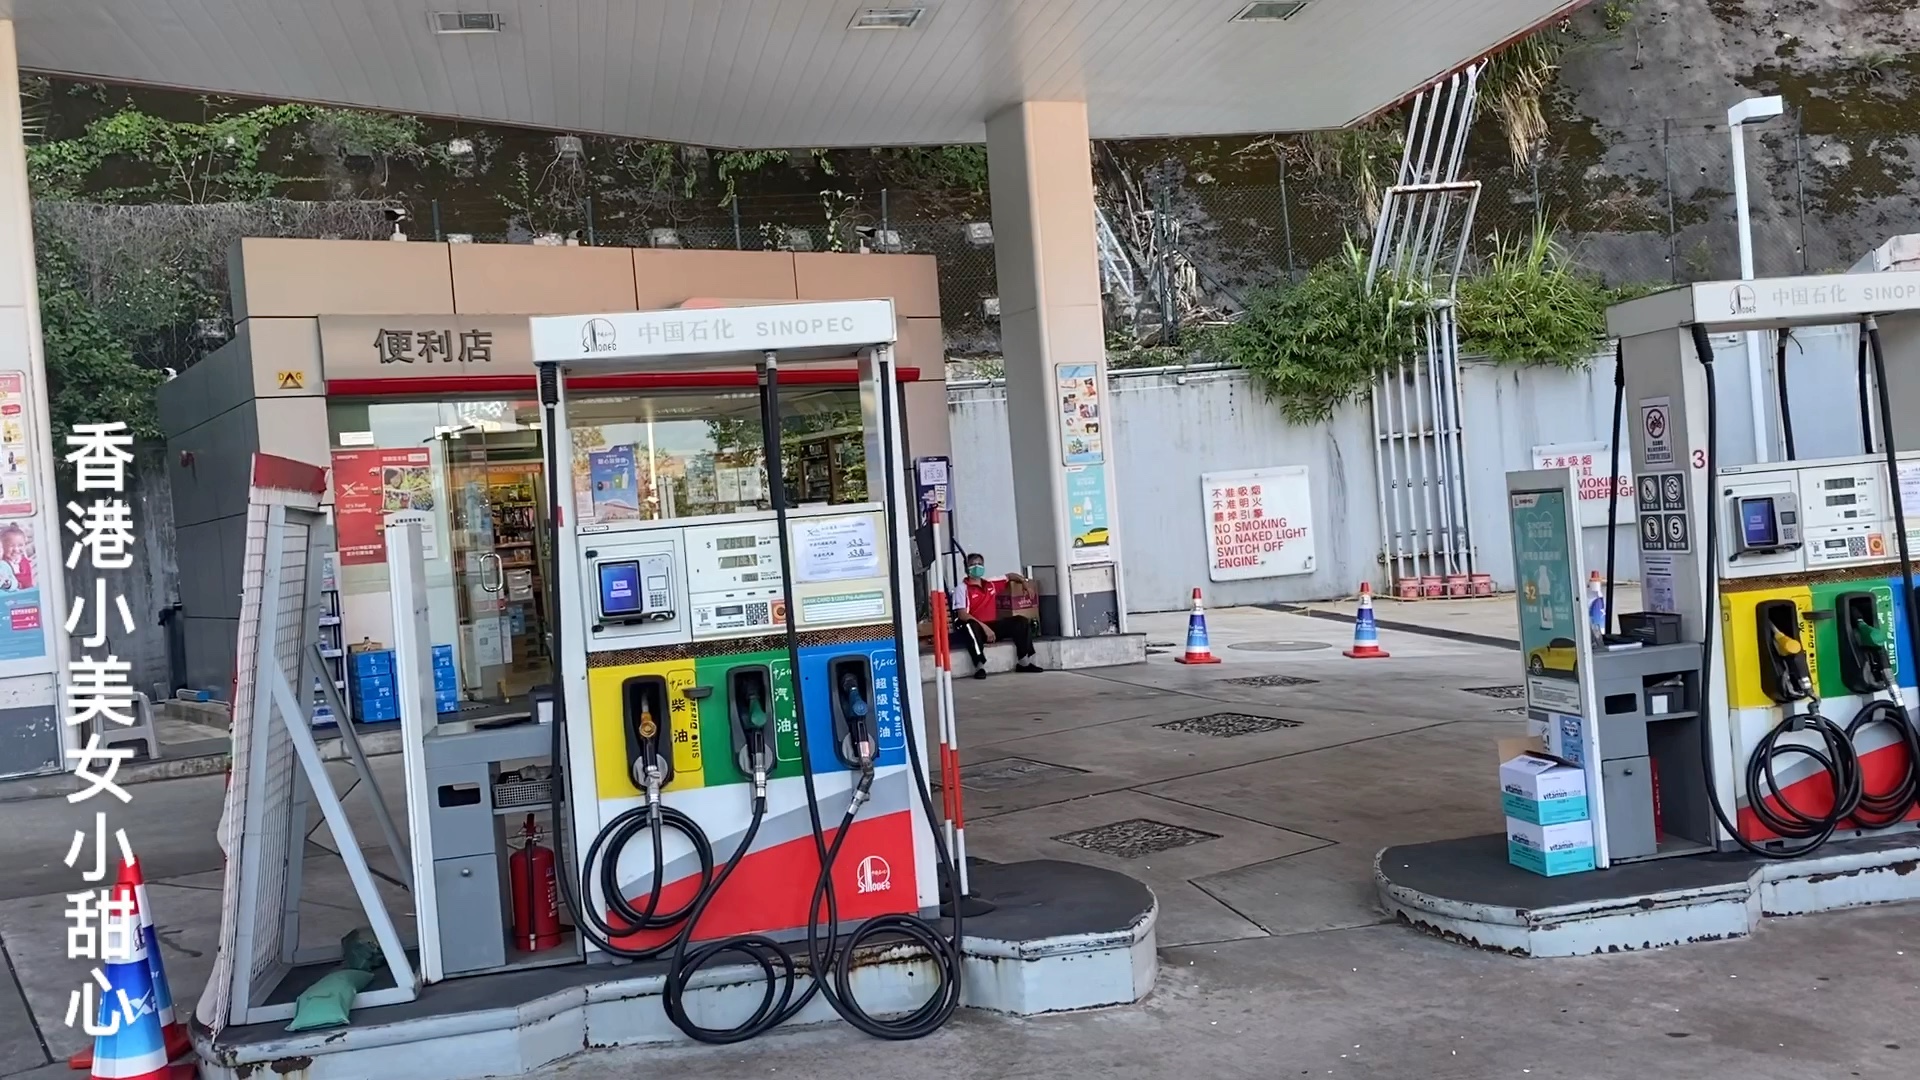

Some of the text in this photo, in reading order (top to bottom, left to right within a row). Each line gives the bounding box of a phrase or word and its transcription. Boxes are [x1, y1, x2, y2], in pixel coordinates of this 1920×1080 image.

[1773, 285, 1846, 306] 中国石化
[1863, 284, 1920, 301] SINOP
[638, 318, 734, 344] 中国石化
[756, 317, 854, 337] SINOPEC
[373, 328, 493, 364] 便利店
[1542, 455, 1592, 468] 不准吸烟
[1692, 449, 1706, 469] 3
[1577, 475, 1627, 488] MOKIG
[1213, 497, 1262, 510] 不准明火
[1214, 517, 1287, 534] NO SMOKING
[1672, 522, 1680, 535] 5
[1216, 527, 1307, 546] NO NAKED LIGHT
[1217, 540, 1284, 557] SWITCH OFF
[1218, 555, 1259, 569] ENGINE
[1525, 585, 1536, 600] $2
[1888, 643, 1896, 665] SINO
[775, 687, 791, 733] 汽油
[672, 698, 688, 743] 柴油
[894, 715, 902, 737] SINO
[691, 734, 700, 759] SINO
